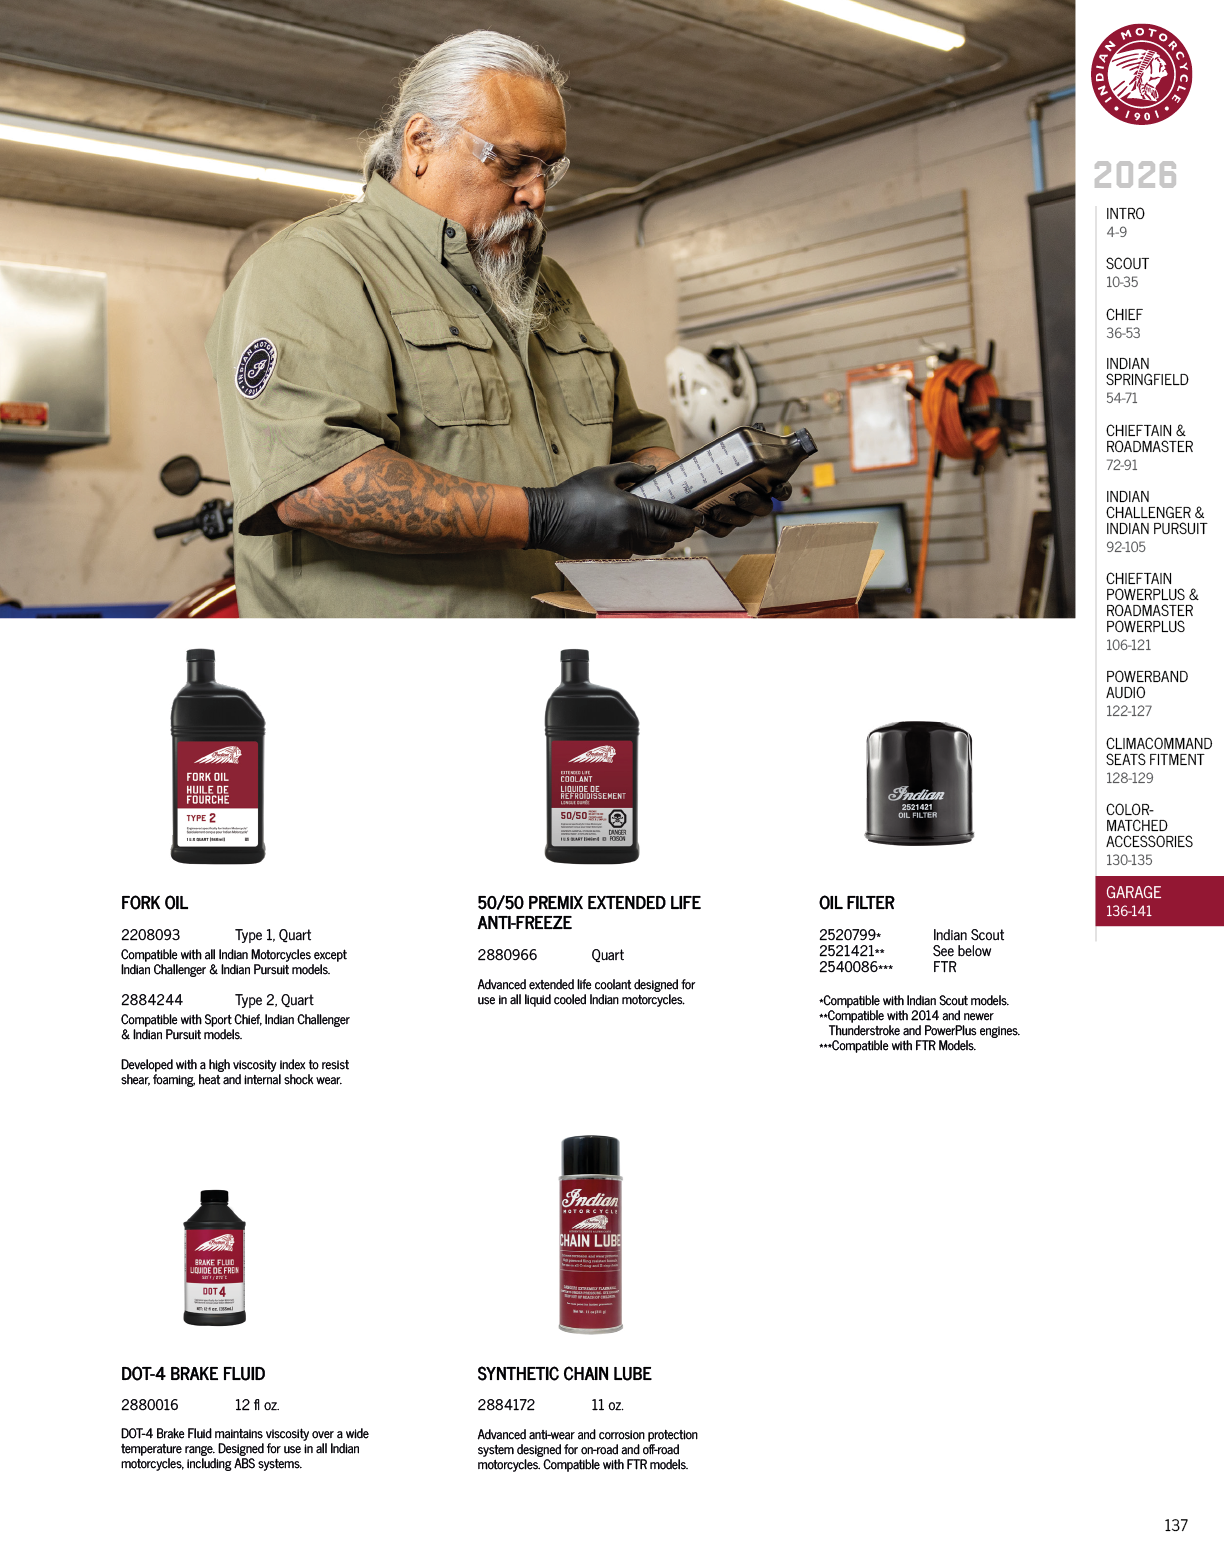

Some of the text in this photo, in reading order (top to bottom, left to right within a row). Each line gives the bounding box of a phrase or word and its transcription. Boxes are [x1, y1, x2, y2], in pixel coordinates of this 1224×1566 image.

[1095, 40, 1116, 103] INDIAN
[1120, 27, 1189, 104] MOTORCYCLE
[1125, 110, 1159, 121] 1901
[1094, 161, 1176, 188] 2026
[1107, 207, 1145, 219] INTRO
[1107, 226, 1127, 237] 4-9
[1106, 308, 1143, 320] CHIEF
[1107, 327, 1140, 338] 36-53
[1106, 737, 1212, 749] CLIMACOMMAND
[1106, 753, 1205, 765] SEATS FITMENT
[186, 772, 229, 781] FORK OIL
[1107, 772, 1153, 783] 128-129
[186, 785, 229, 794] HUILE DE
[888, 786, 945, 801] Indian
[186, 795, 230, 805] FOURCHE
[209, 813, 216, 823] 2
[560, 811, 587, 821] 50/50
[1107, 886, 1161, 898] GARAGE
[122, 895, 188, 910] FORK OIL
[478, 895, 701, 910] 50/50 PREMIX EXTENDED LIFE
[819, 895, 895, 910] OIL FILTER
[1107, 905, 1152, 916] 136-141
[477, 916, 572, 929] ANTI-FREEZE
[122, 994, 183, 1005] 2884244
[235, 994, 314, 1008] Type 2, Quart
[561, 1188, 618, 1208] Indian
[559, 1234, 621, 1247] CHAIN LUBE
[203, 1286, 226, 1297] DOT 4
[122, 1366, 265, 1381] DOT-4 BRAKE FLUID
[478, 1366, 652, 1381] SYNTHETIC CHAIN LUBE
[122, 1399, 178, 1410] 2880016
[121, 1458, 302, 1471] motorcycles, including ABS systems.
[1165, 1519, 1188, 1531] 137
